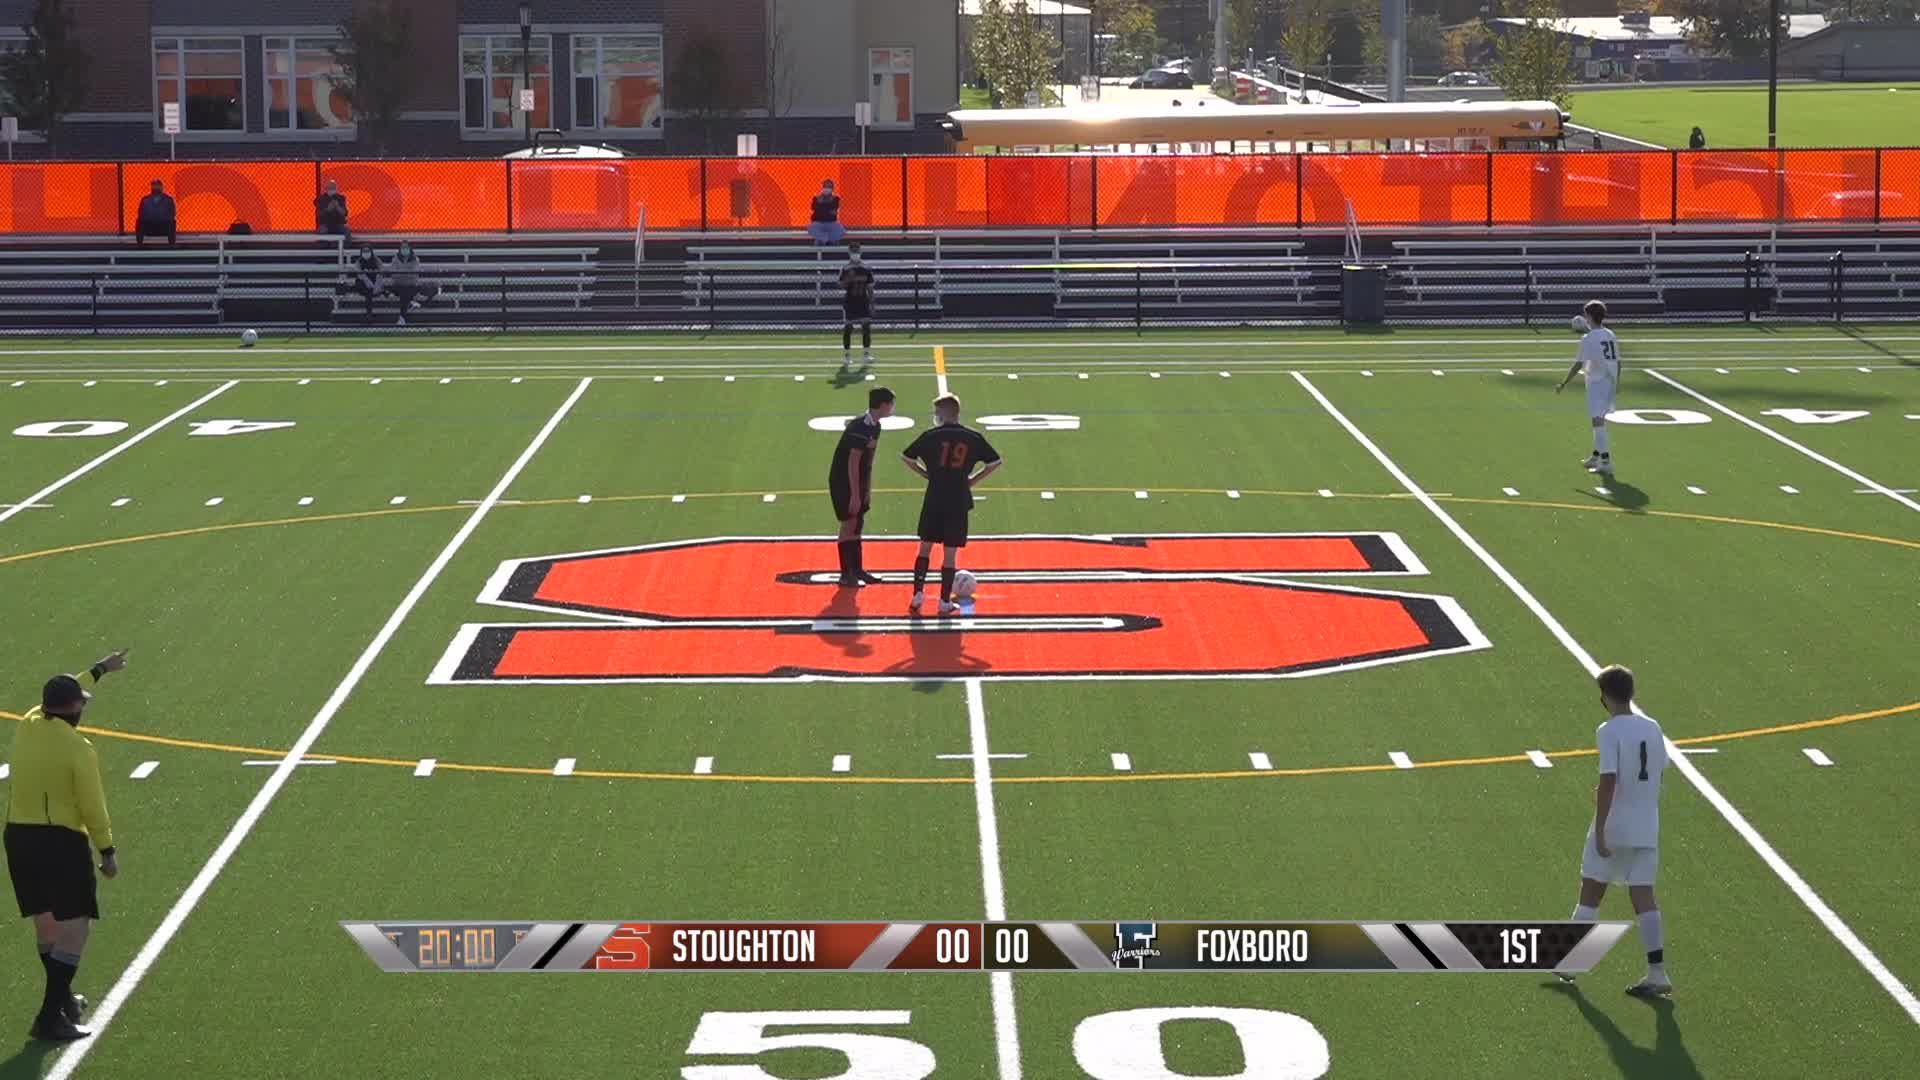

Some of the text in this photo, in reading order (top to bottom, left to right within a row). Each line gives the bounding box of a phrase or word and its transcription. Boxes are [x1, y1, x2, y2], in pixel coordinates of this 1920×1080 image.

[1600, 340, 1617, 359] 21
[940, 441, 969, 469] 19
[1638, 740, 1649, 782] 1
